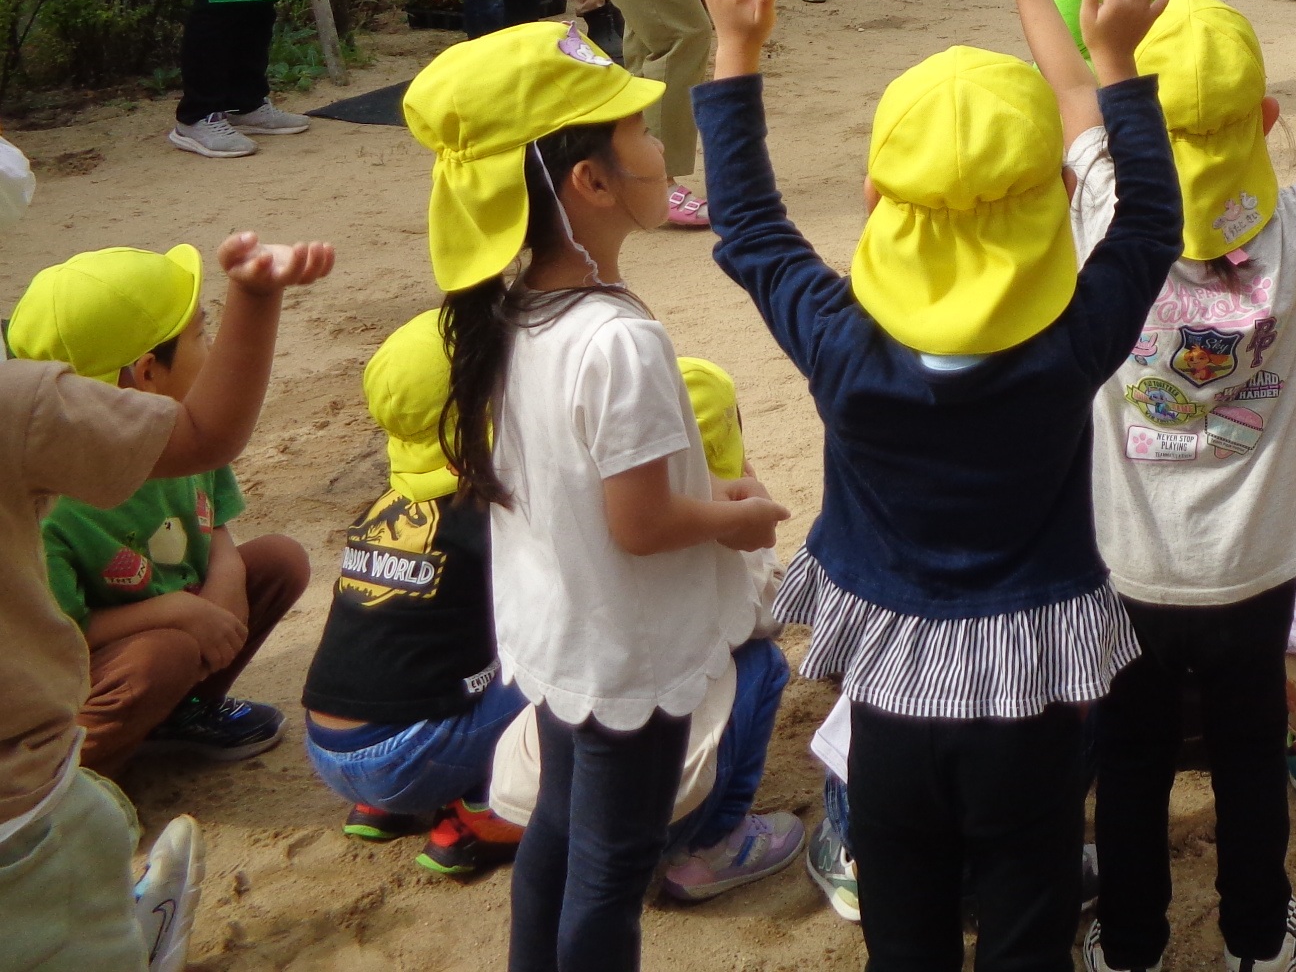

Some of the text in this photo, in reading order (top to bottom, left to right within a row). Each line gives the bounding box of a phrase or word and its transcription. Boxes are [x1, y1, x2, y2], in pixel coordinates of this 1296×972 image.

[1239, 389, 1279, 399] HARDER
[1156, 433, 1195, 443] NEVER STOP
[1161, 441, 1188, 452] PLAYING
[371, 550, 435, 585] WORLD
